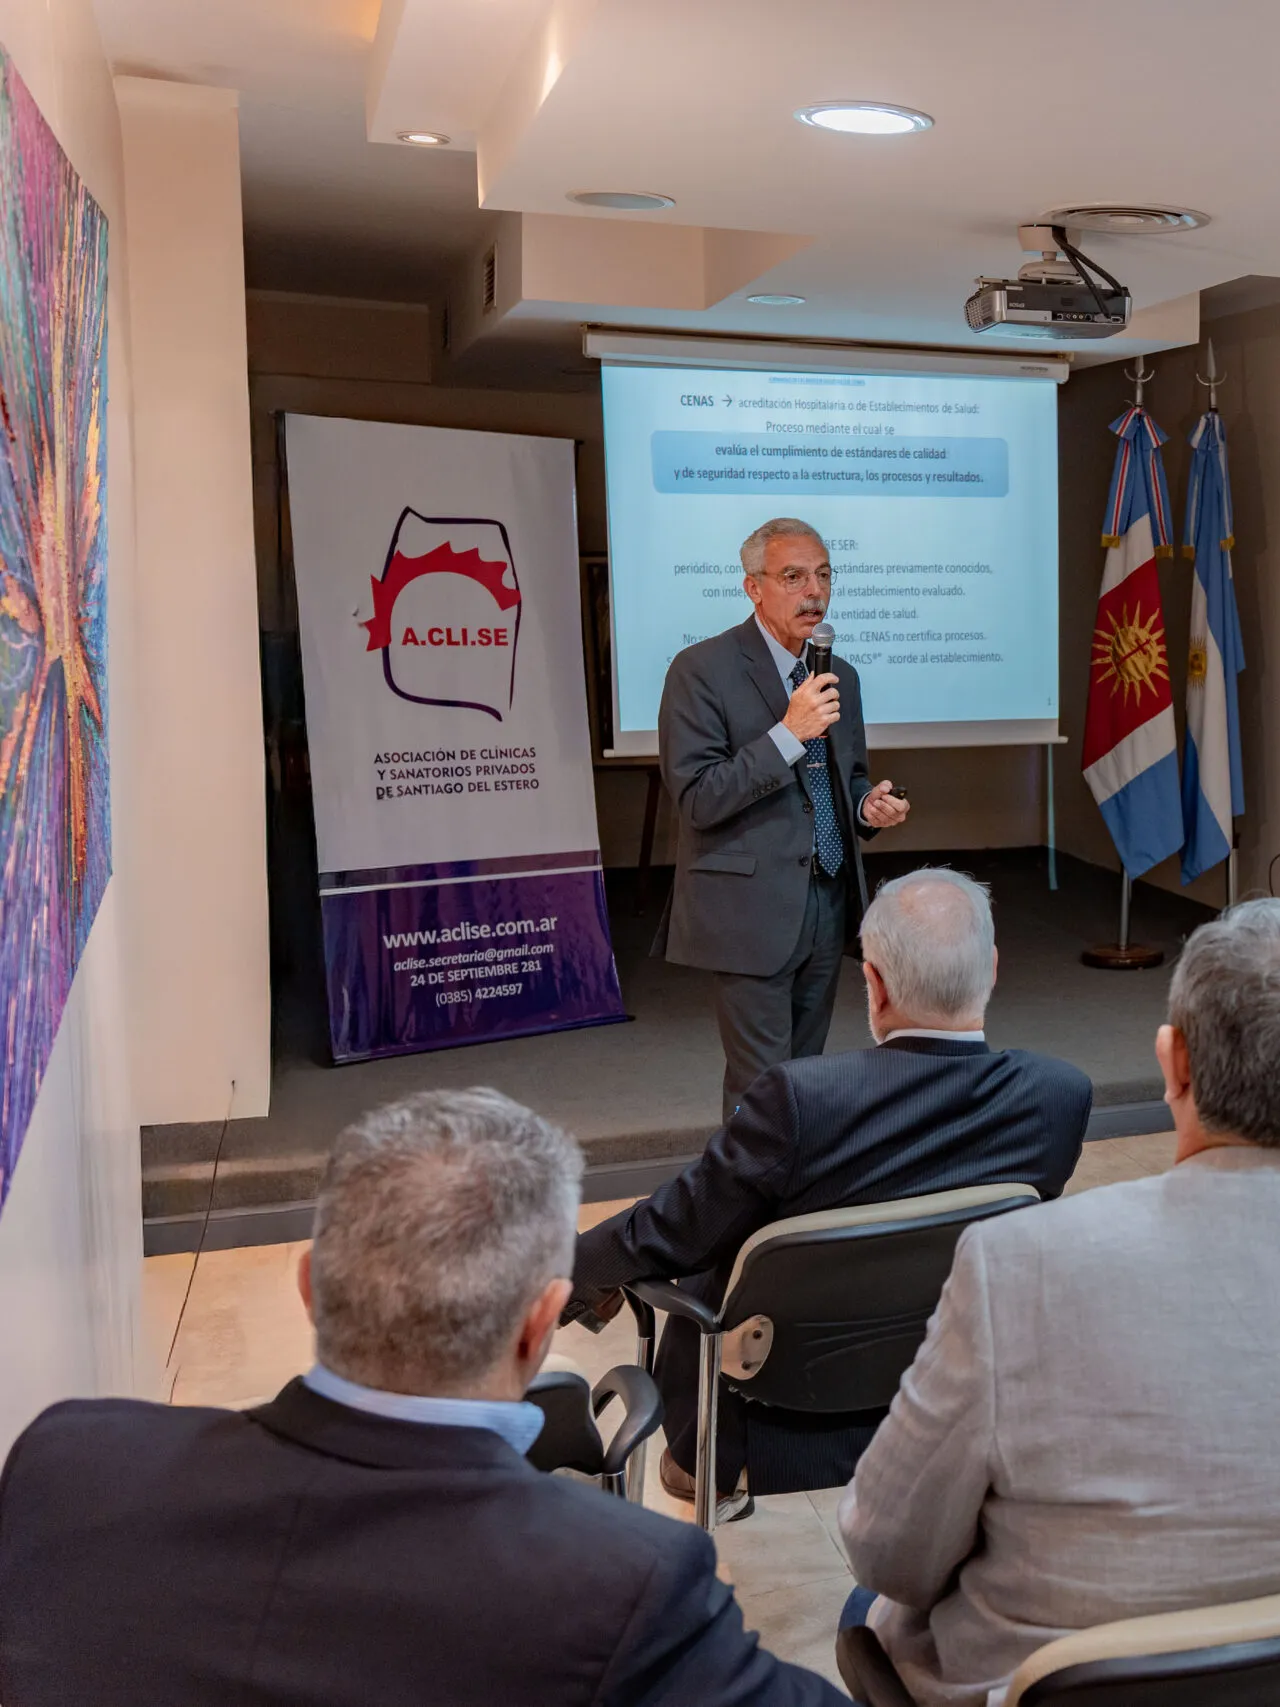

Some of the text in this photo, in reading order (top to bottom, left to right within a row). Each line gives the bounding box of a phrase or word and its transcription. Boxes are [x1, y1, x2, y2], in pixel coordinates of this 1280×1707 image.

[681, 394, 714, 407] CENAS
[738, 398, 792, 409] acreditación
[795, 400, 845, 411] Hospitalaria
[856, 401, 867, 411] de
[870, 401, 939, 413] Establecimientos
[942, 403, 952, 414] de
[766, 421, 895, 436] Proceso mediante el cual se
[715, 444, 946, 460] evalúa el cumplimiento de estándares de calidad
[673, 467, 984, 484] y de seguridad respecto a la estructura, los procesos y resultados.
[674, 562, 722, 576] periódico,
[833, 562, 993, 575] estándares previamente conocidos,
[702, 588, 720, 598] con
[836, 586, 845, 597] al
[847, 585, 920, 597] establecimiento
[922, 585, 966, 597] evaluado.
[830, 609, 839, 619] la
[841, 608, 876, 620] entidad
[878, 608, 891, 619] de
[892, 607, 918, 619] salud.
[402, 627, 508, 647] A.CLI.SE
[859, 631, 890, 643] CENAS
[892, 633, 905, 642] no
[906, 630, 942, 642] certifica
[945, 631, 987, 643] procesos.
[887, 653, 918, 664] acorde
[920, 653, 928, 664] al
[930, 652, 1003, 664] establecimiento.
[374, 745, 536, 764] ASOCIACIÓN DE CLÍNICAS
[377, 763, 535, 781] Y SANATORIOS PRIVADOS
[376, 779, 539, 799] DE SANTIAGO DEL ESTERO
[383, 916, 558, 949] www.aclise.com.ar
[393, 943, 554, 972] aclise.secretaria@gmail.com
[410, 959, 542, 987] 24 DE SEPTIEMBRE 281
[435, 982, 523, 1008] (0385) 4224597
